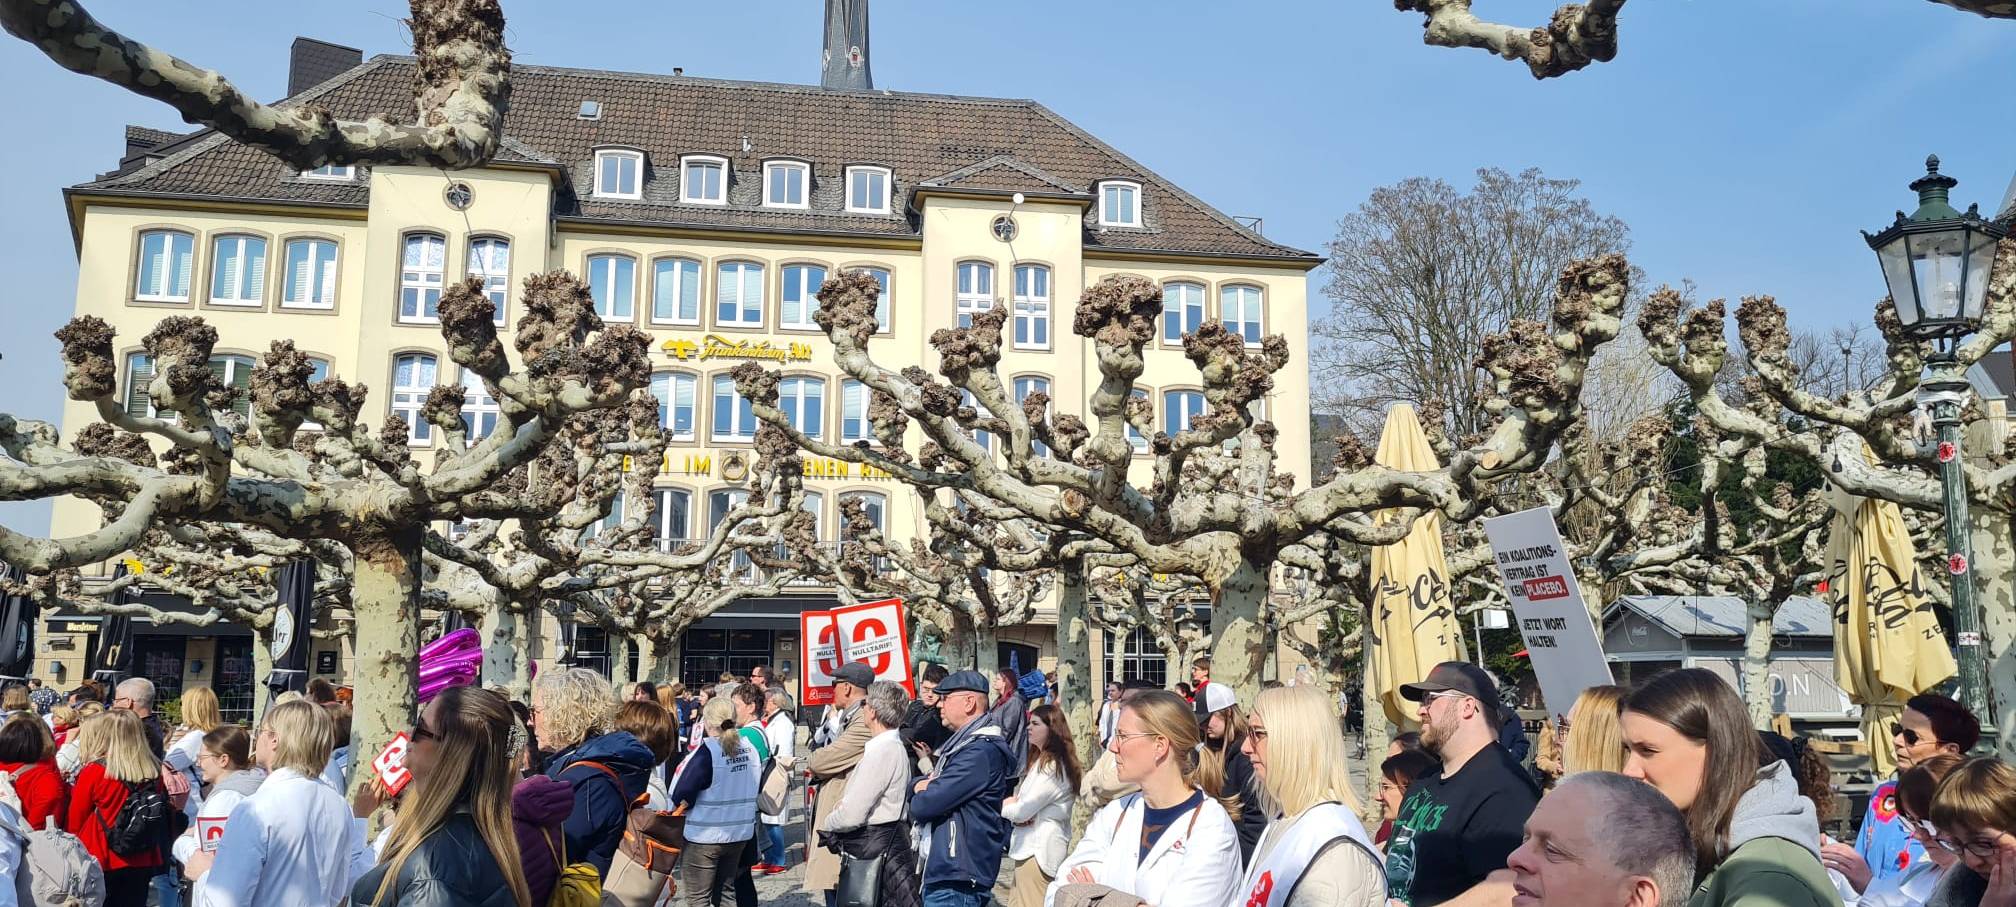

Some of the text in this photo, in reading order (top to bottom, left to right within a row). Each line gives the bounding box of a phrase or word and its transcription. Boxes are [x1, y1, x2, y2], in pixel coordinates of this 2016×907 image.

[700, 335, 786, 364] Frankenheim
[685, 455, 711, 476] IM
[803, 458, 848, 478] ENEN
[1498, 545, 1557, 564] EIN KOALITIONS-
[1504, 564, 1549, 580] VERTRAG IST
[1510, 581, 1566, 597] KEIN PLACEBO.
[1523, 617, 1567, 631] JETZT WORT
[852, 641, 893, 657] NULLTARIF!
[1527, 636, 1557, 648] HALTEN!
[816, 649, 836, 657] NULLT
